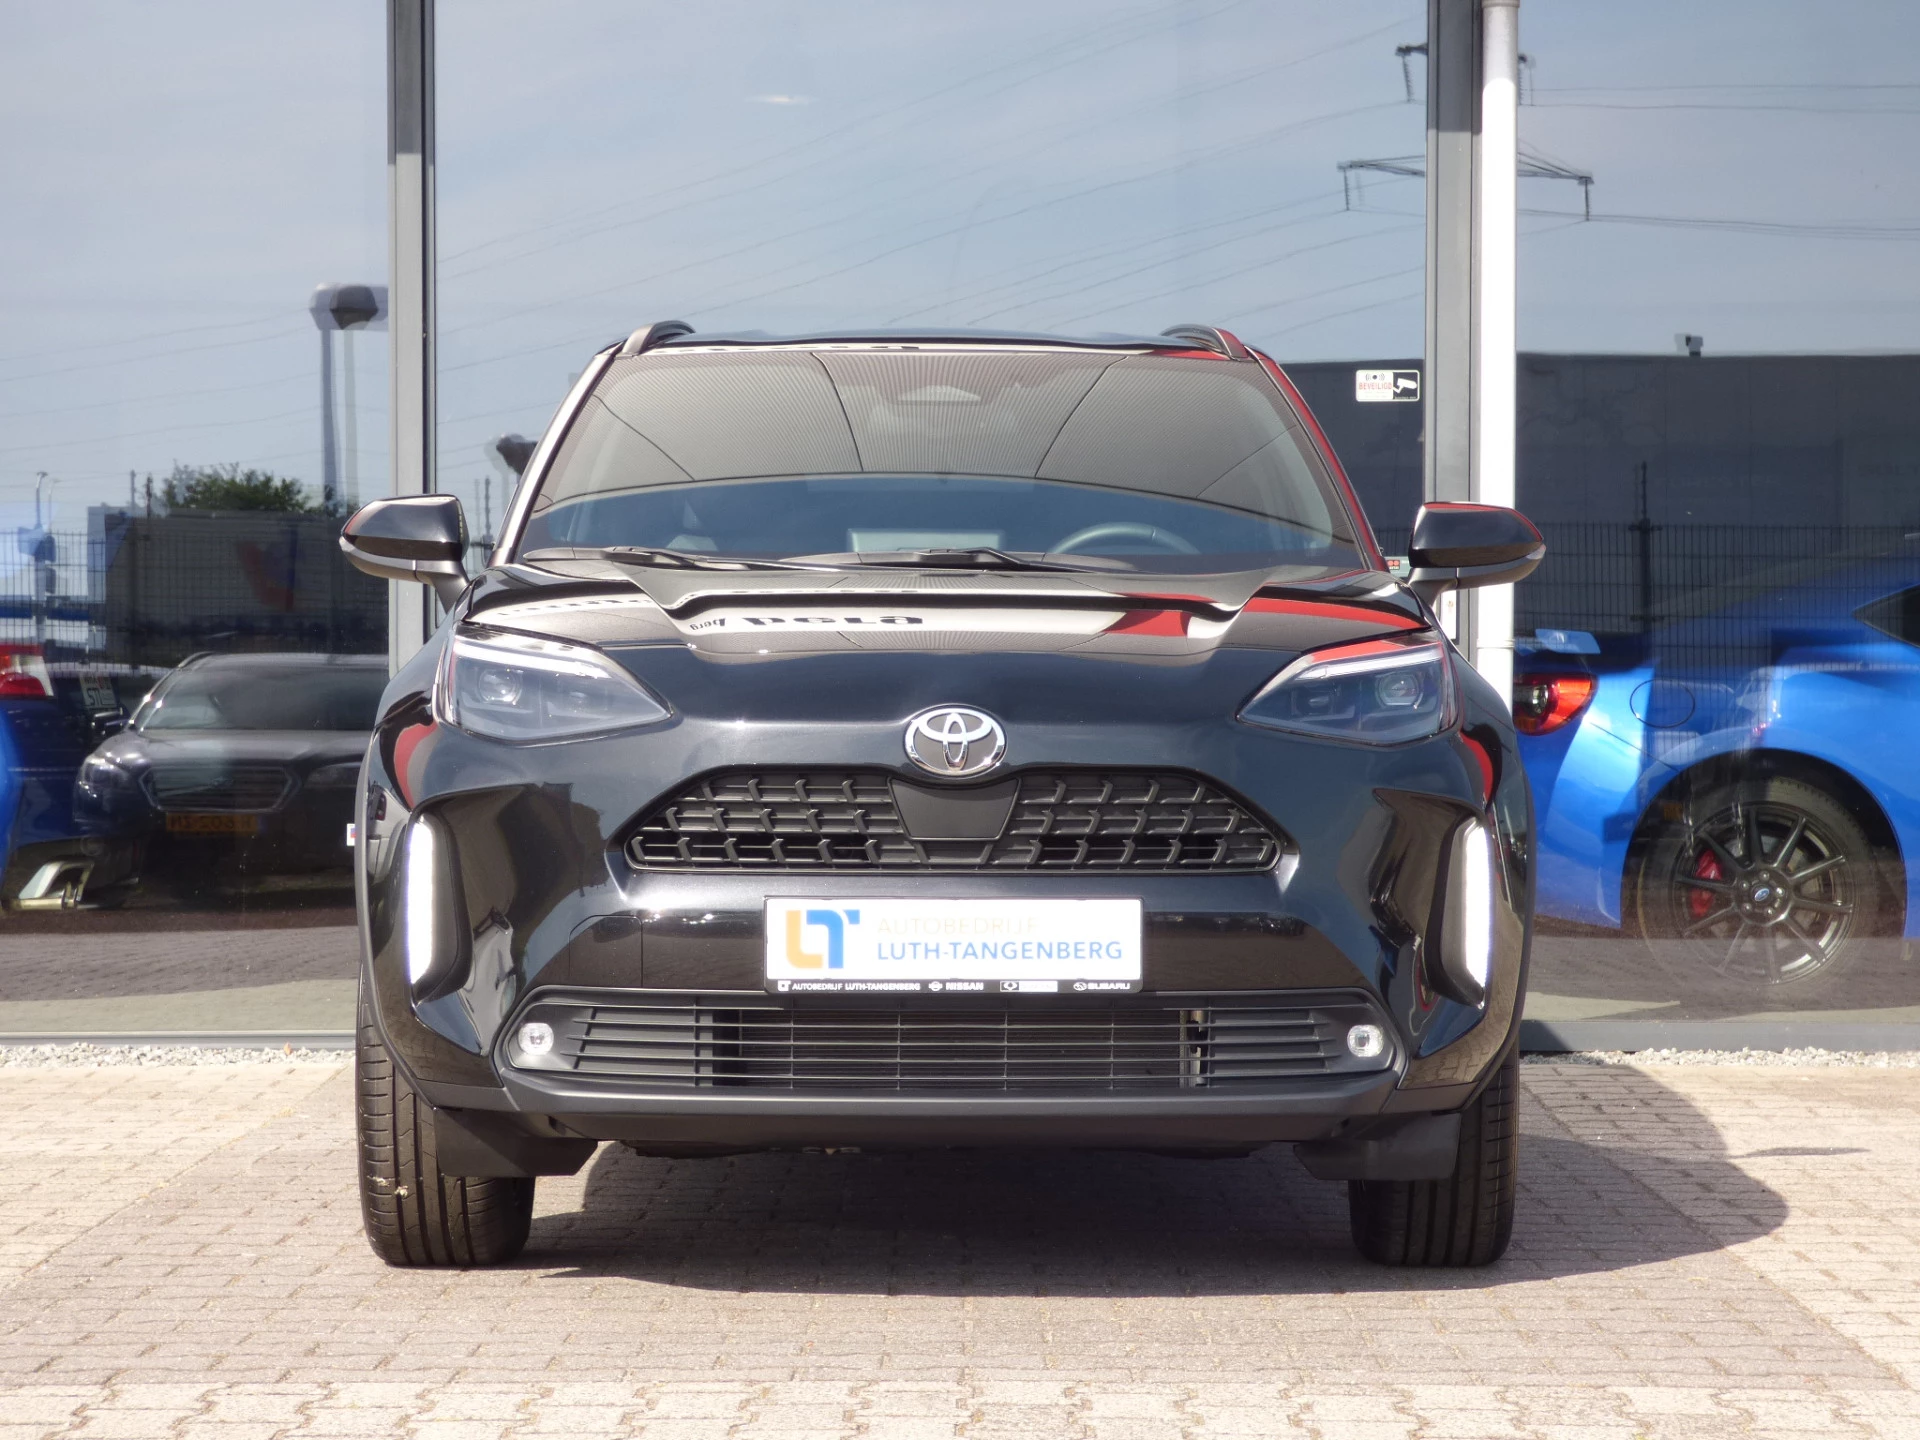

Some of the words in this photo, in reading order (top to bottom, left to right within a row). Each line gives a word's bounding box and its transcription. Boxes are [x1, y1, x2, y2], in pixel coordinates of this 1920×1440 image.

[878, 917, 1039, 935] AUTOBEDRIJF
[878, 942, 1122, 960] LUTH-TANGENBERG
[946, 982, 984, 991] NISSAN
[1088, 982, 1131, 990] SUBARU
